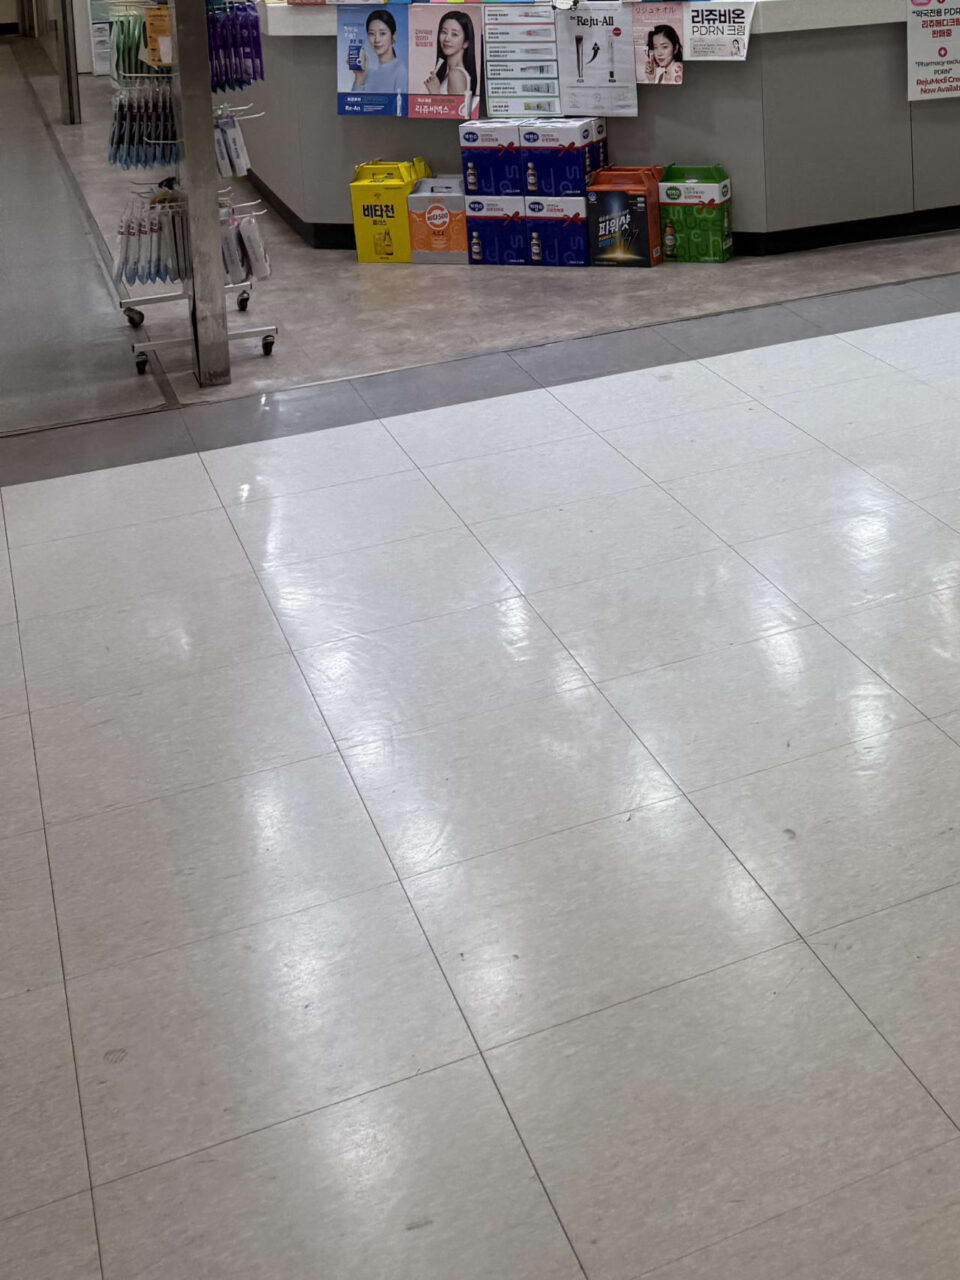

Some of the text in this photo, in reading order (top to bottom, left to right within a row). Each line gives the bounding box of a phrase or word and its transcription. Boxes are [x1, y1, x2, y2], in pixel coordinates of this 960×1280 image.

[577, 15, 614, 28] Reju-All
[691, 8, 746, 25] 리쥬비온
[692, 25, 746, 36] PDRN 크림
[362, 204, 395, 219] 비타천
[598, 214, 631, 236] 파워샷
